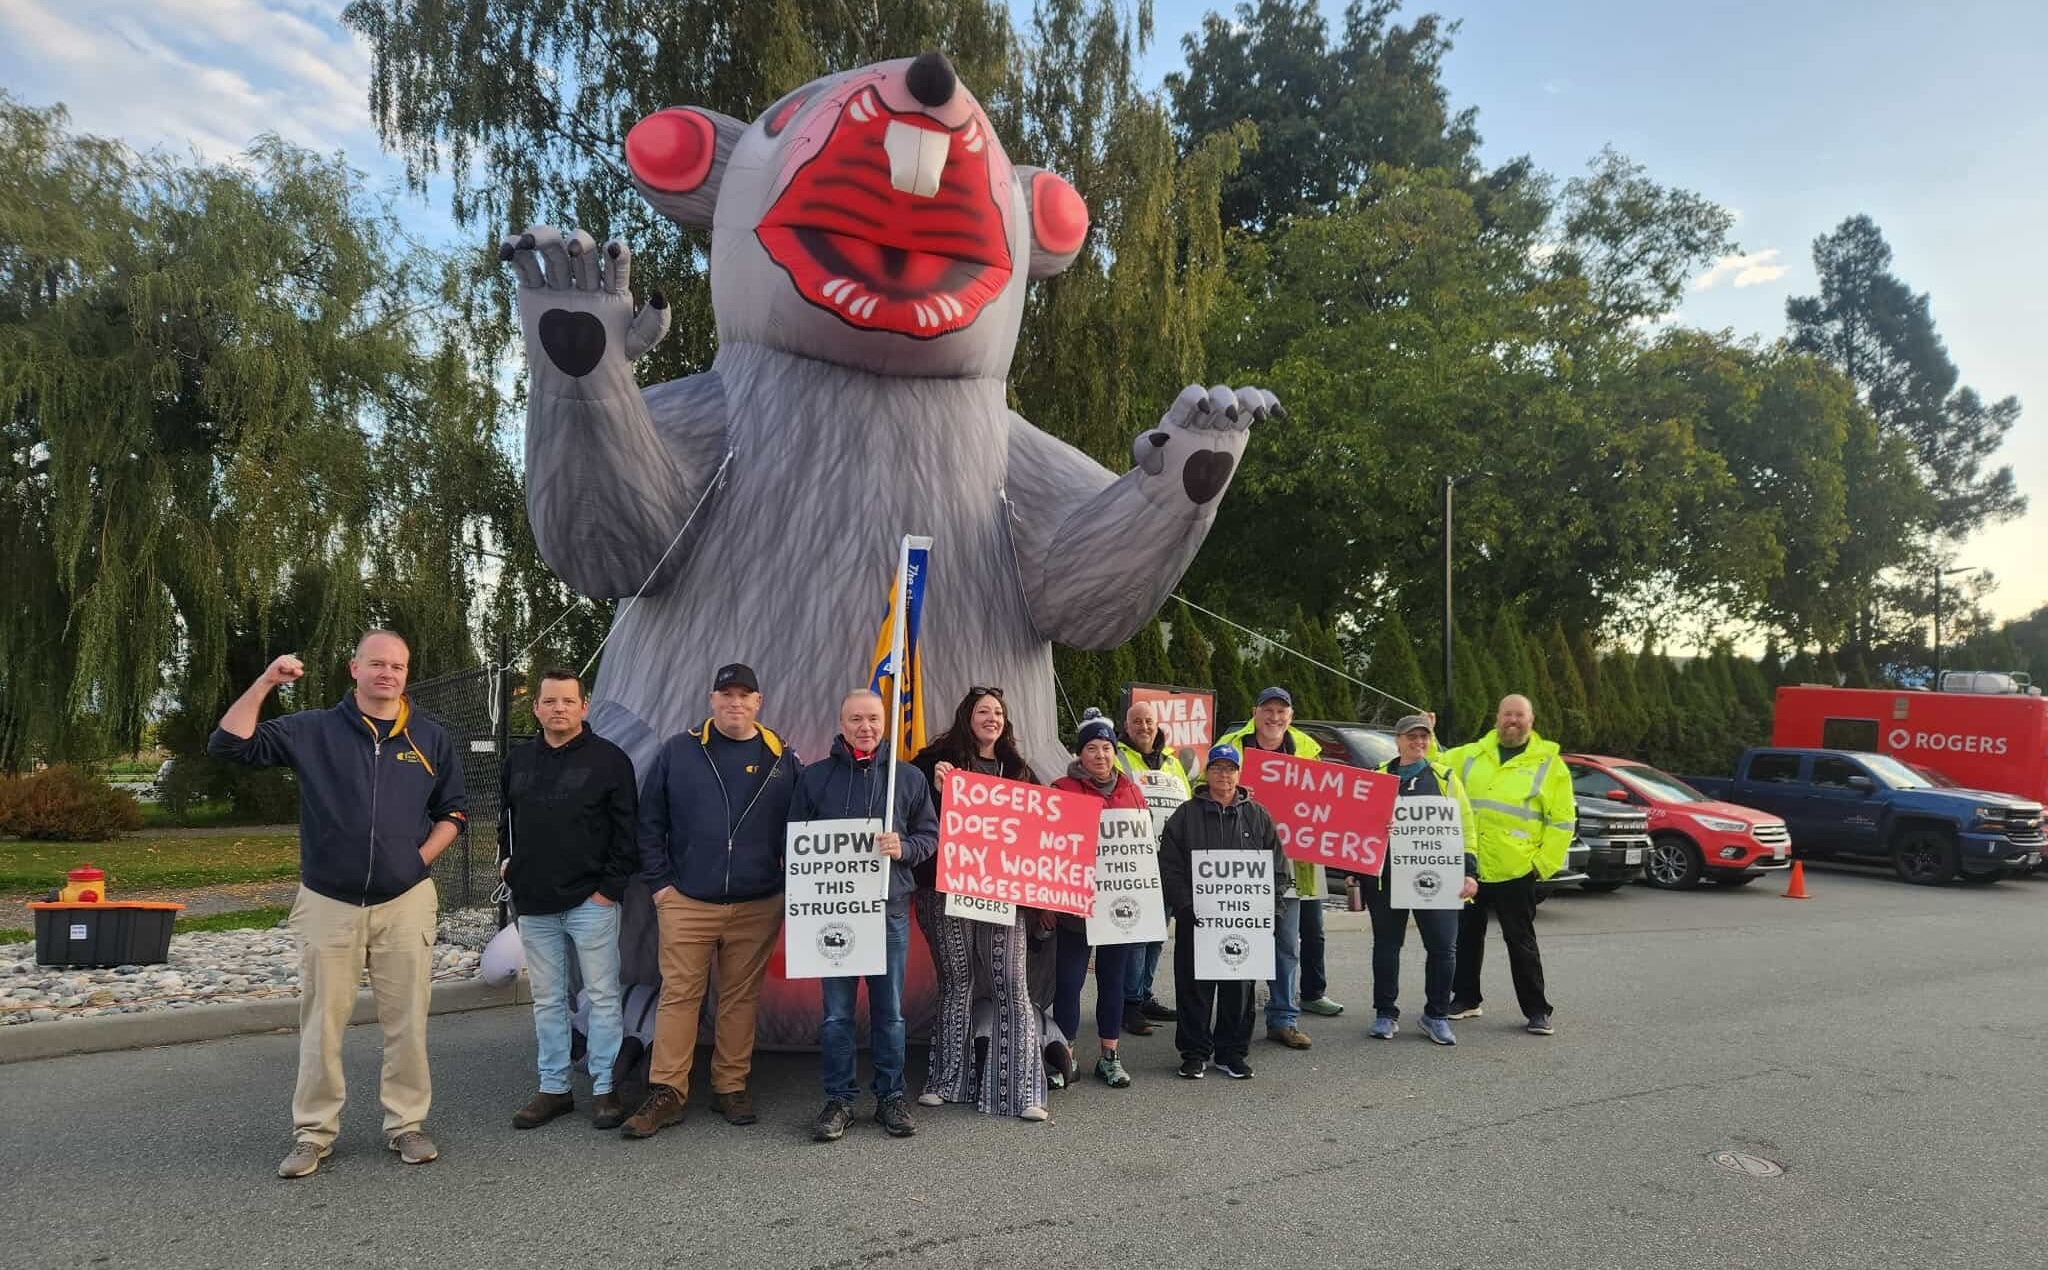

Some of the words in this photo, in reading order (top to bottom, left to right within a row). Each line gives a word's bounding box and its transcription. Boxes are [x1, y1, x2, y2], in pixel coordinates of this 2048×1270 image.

[1191, 698, 1207, 721] A
[1157, 720, 1209, 746] ONK
[1915, 732, 2009, 755] ROGERS
[1260, 760, 1374, 801] SHAME
[951, 775, 1062, 822] ROGERS
[1295, 802, 1331, 823] ON
[1394, 806, 1454, 821] CUPW
[946, 810, 1020, 844] DOES
[1040, 831, 1085, 855] NOT
[1099, 820, 1147, 839] UPW
[1392, 826, 1460, 836] SUPPORTS
[793, 832, 875, 855] CUPW
[1276, 823, 1383, 866] OGERS
[1412, 841, 1442, 850] THIS
[790, 860, 880, 875] SUPPORTS
[944, 842, 988, 877] PAY
[1001, 850, 1096, 890] WORKER
[1105, 861, 1137, 873] THIS
[1393, 855, 1462, 865] STRUGGLE
[1198, 861, 1266, 878] CUPW
[815, 880, 855, 895] THIS
[945, 872, 1022, 900] WAGES
[1025, 883, 1096, 913] EQUALLY
[1095, 878, 1159, 891] TRUGGLE
[1196, 883, 1271, 895] SUPPORTS
[789, 900, 881, 916] STRUGGLE
[954, 894, 1009, 915] ROGERS
[1217, 901, 1250, 911] THIS
[1197, 917, 1271, 928] STRUGGLE
